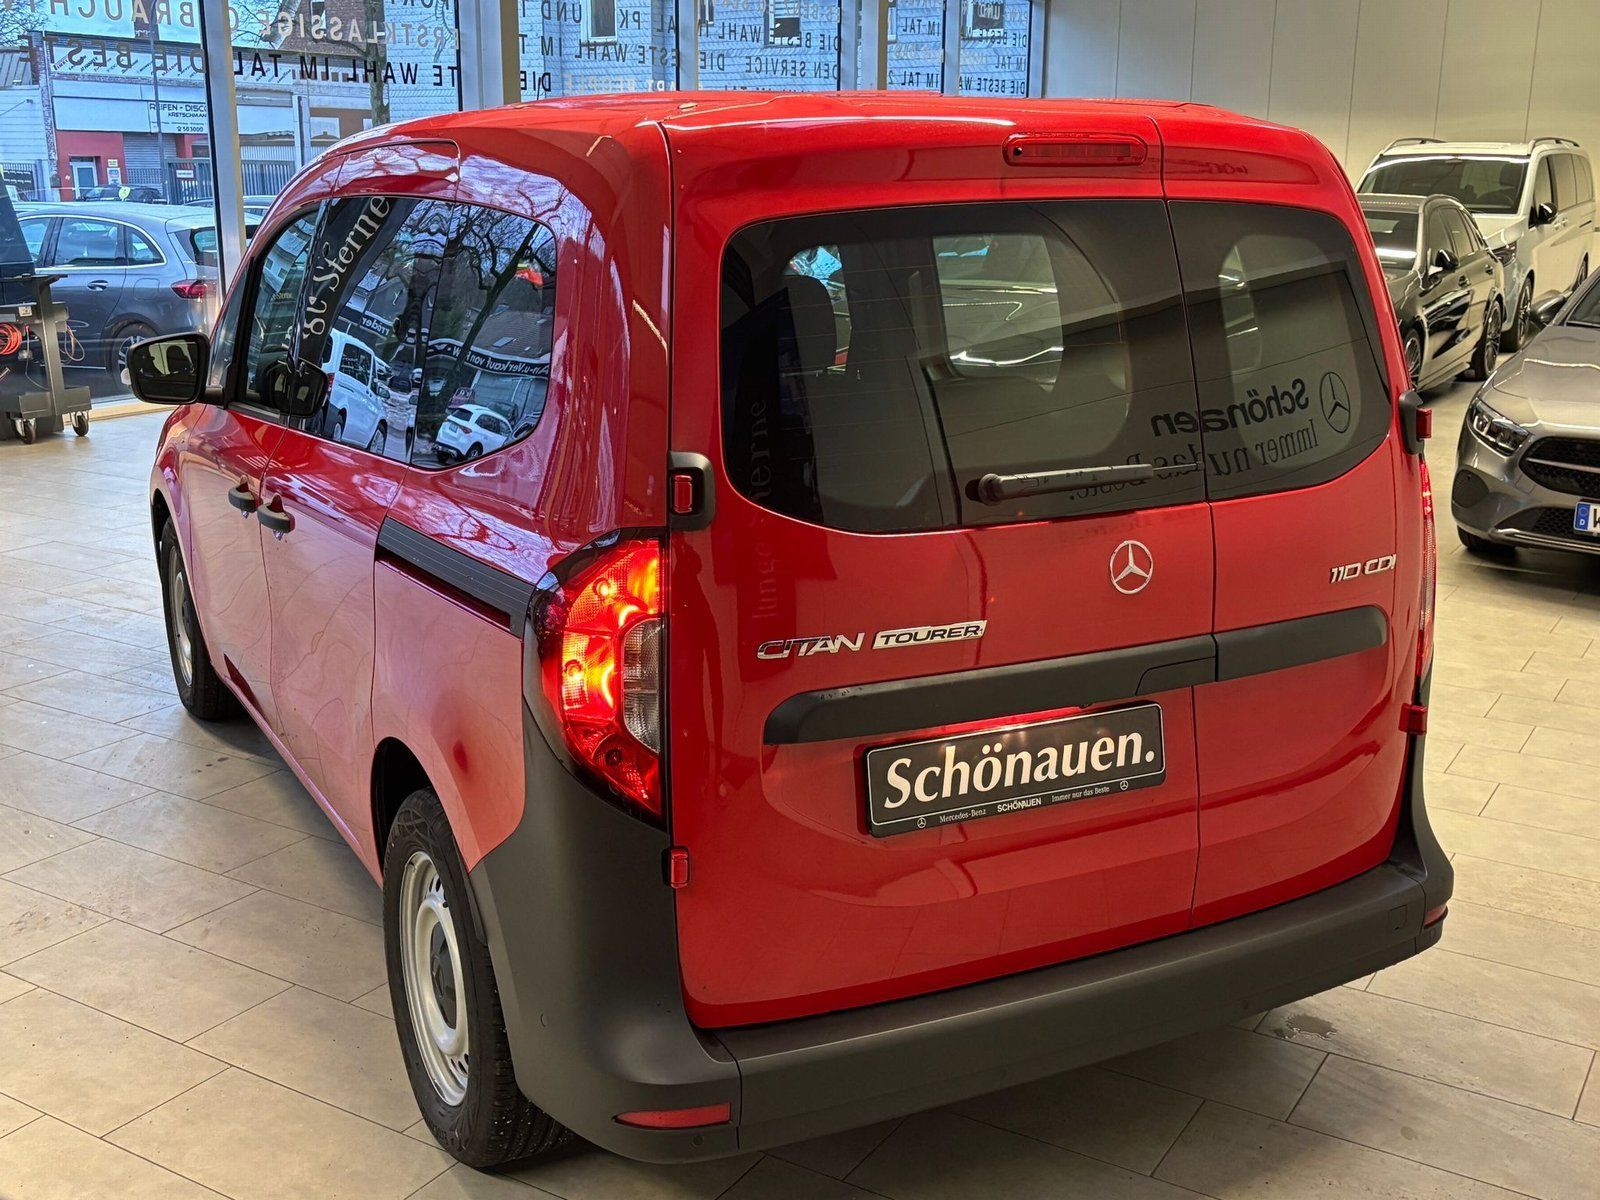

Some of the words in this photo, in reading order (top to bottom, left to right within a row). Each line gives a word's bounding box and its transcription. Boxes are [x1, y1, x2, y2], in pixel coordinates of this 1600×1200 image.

[149, 102, 178, 111] RIFEN
[312, 196, 390, 292] Sterne
[1329, 562, 1361, 584] 110
[1363, 553, 1397, 576] CDI
[757, 632, 866, 660] CITAN
[879, 624, 984, 646] TOURER
[883, 732, 1155, 810] Schönauen.
[939, 808, 987, 823] Mercedes-Benz
[1051, 794, 1071, 803] Immer
[1094, 786, 1110, 795] Beste
